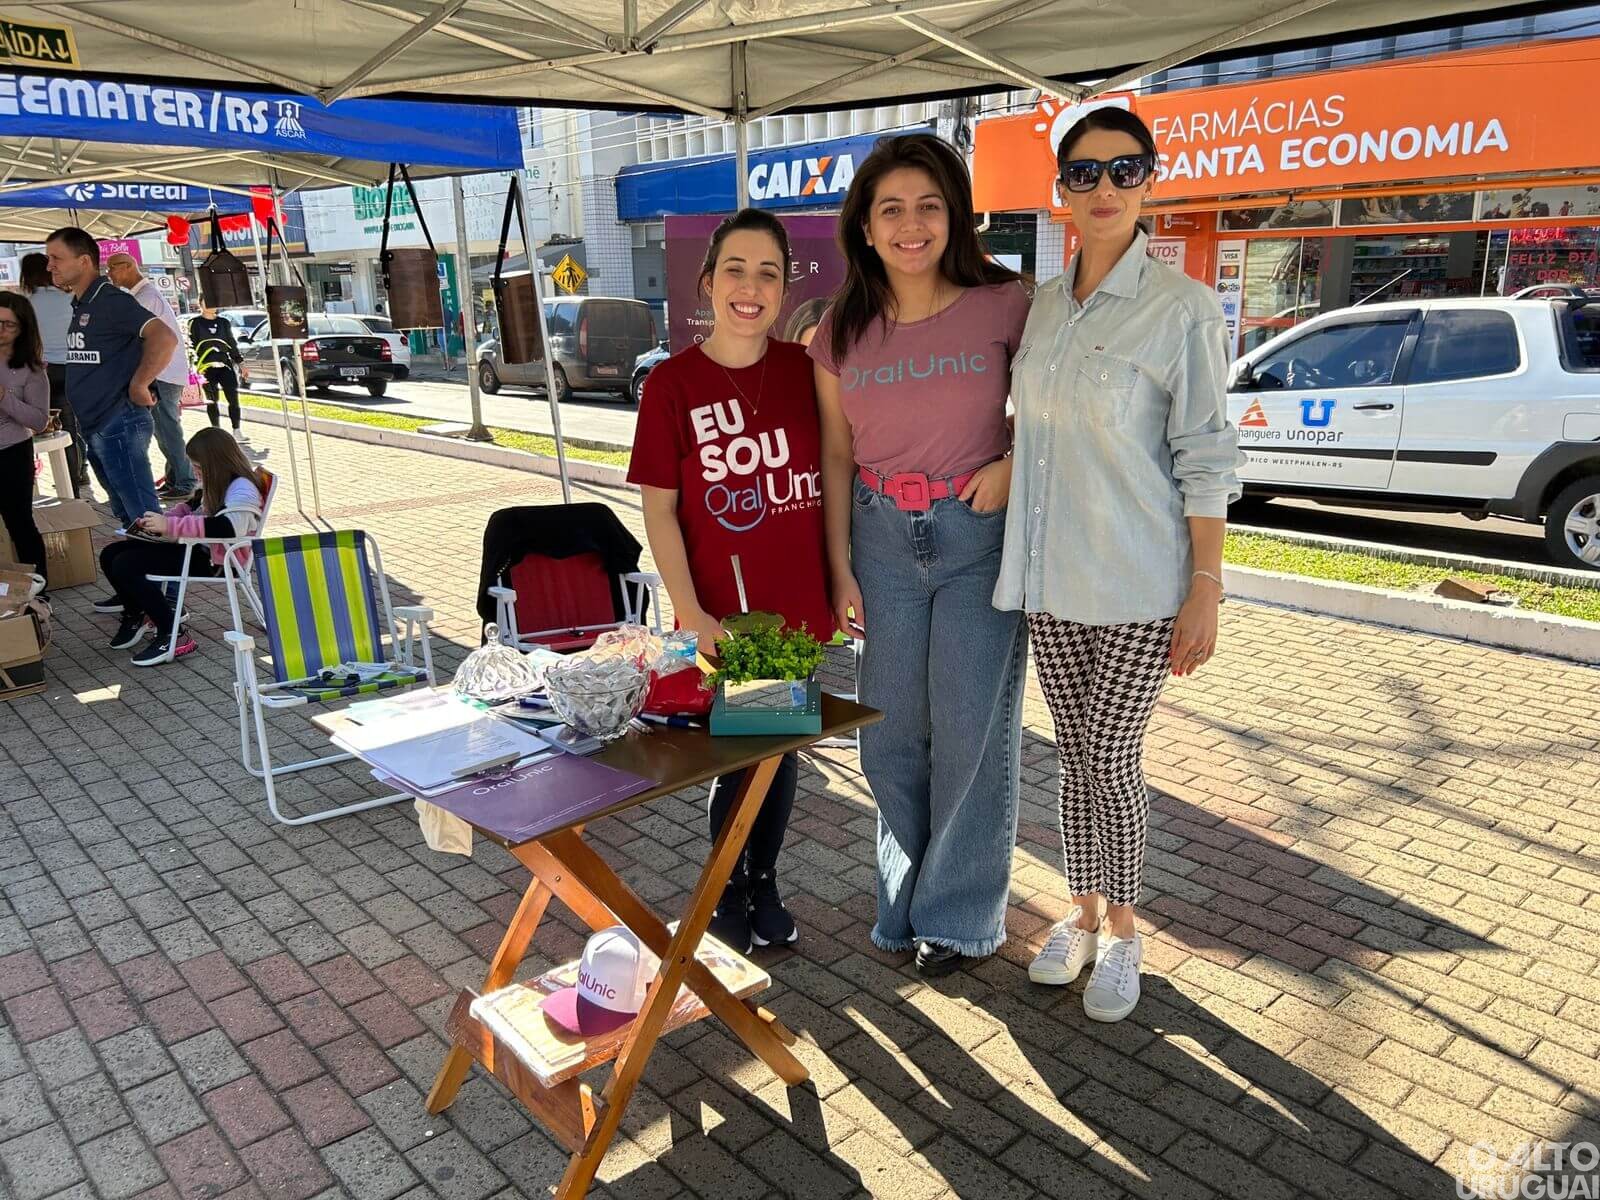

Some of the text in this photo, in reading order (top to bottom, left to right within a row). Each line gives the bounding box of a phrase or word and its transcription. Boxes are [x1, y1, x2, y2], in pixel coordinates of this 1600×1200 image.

[19, 76, 268, 134] EMATER/RS
[1152, 95, 1345, 146] FARMÁCIAS
[275, 128, 307, 139] ASCAR
[1155, 118, 1509, 183] SANTA ECONOMIA
[748, 154, 856, 201] CAIXA
[690, 398, 745, 445] EU
[1286, 430, 1344, 445] unopar
[700, 428, 790, 482] SOU
[1272, 459, 1343, 468] WESTPHALEN-RS
[472, 765, 553, 796] OralUnic
